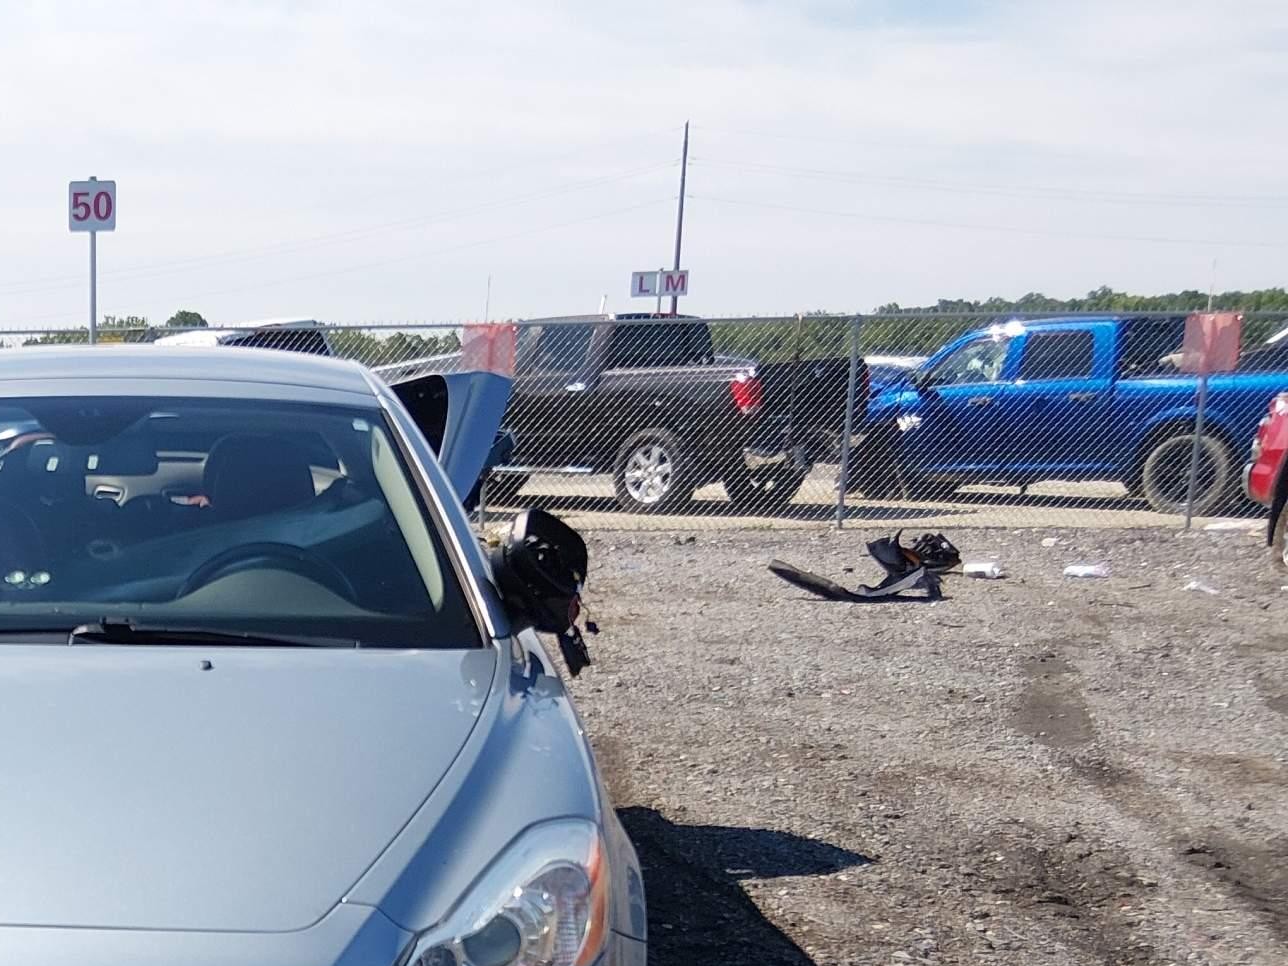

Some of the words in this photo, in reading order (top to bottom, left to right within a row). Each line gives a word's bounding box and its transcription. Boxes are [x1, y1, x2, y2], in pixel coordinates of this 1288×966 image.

[72, 191, 113, 222] 50
[638, 275, 650, 293] L
[665, 274, 686, 292] M
